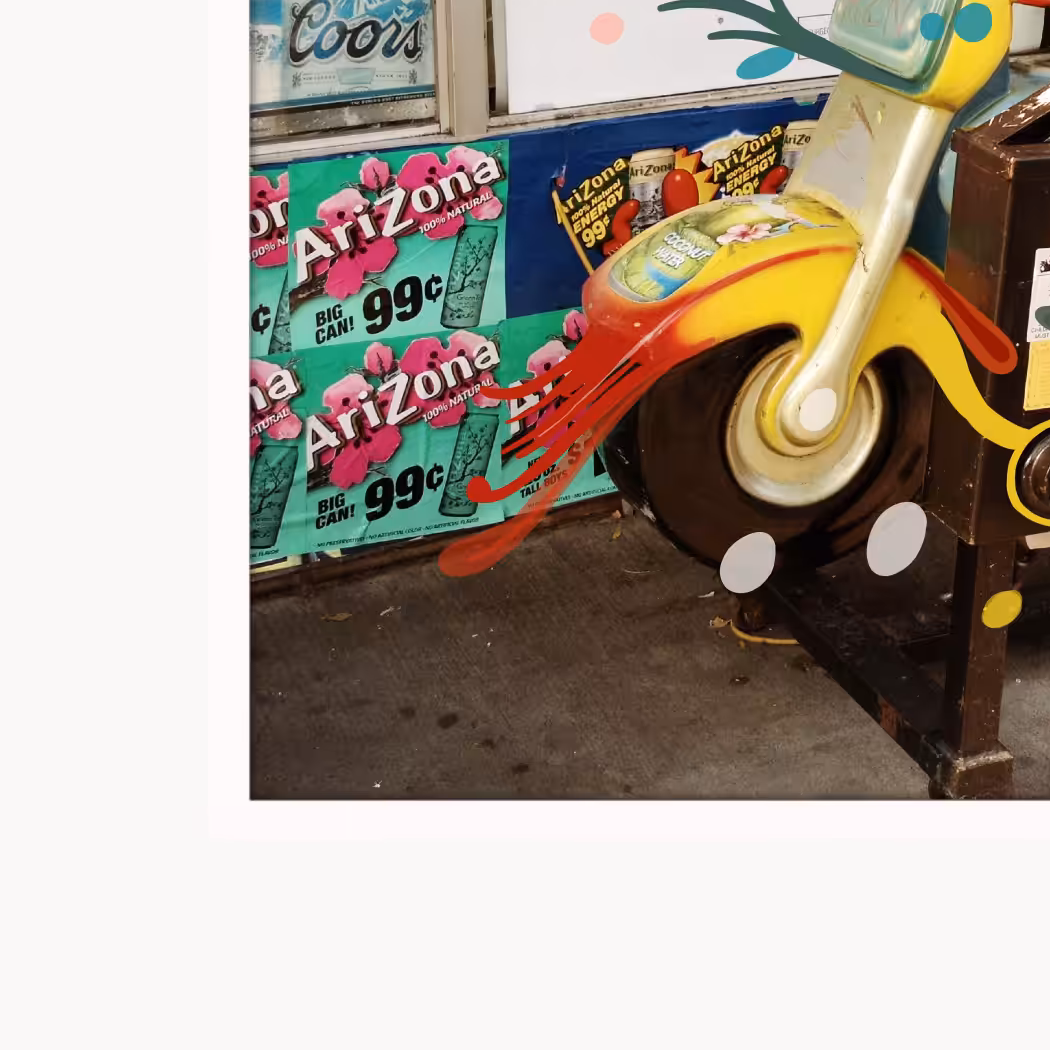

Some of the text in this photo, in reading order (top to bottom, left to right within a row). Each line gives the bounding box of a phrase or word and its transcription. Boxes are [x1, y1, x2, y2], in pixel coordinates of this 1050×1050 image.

[714, 125, 783, 182] AriZona
[784, 134, 811, 145] AriZo
[726, 145, 775, 181] 100% Natural
[727, 152, 777, 192] ENERGY
[419, 192, 492, 234] 100% NATURAL
[571, 178, 620, 222] 100% Natural
[573, 186, 624, 234] ENERGY
[295, 157, 500, 284] AriZona
[582, 214, 610, 248] 99¢
[652, 245, 685, 269] WATER
[664, 232, 713, 261] COCONUT
[316, 304, 343, 327] BIG
[362, 274, 443, 335] 99¢
[315, 316, 354, 344] CAN!
[306, 341, 500, 472] AriZona
[423, 378, 493, 423] 100% NATURAL
[250, 407, 291, 437] ATURAL
[318, 493, 345, 516] BIG
[365, 463, 445, 523] 99¢
[520, 482, 541, 498] TALL
[315, 504, 356, 530] CAN!
